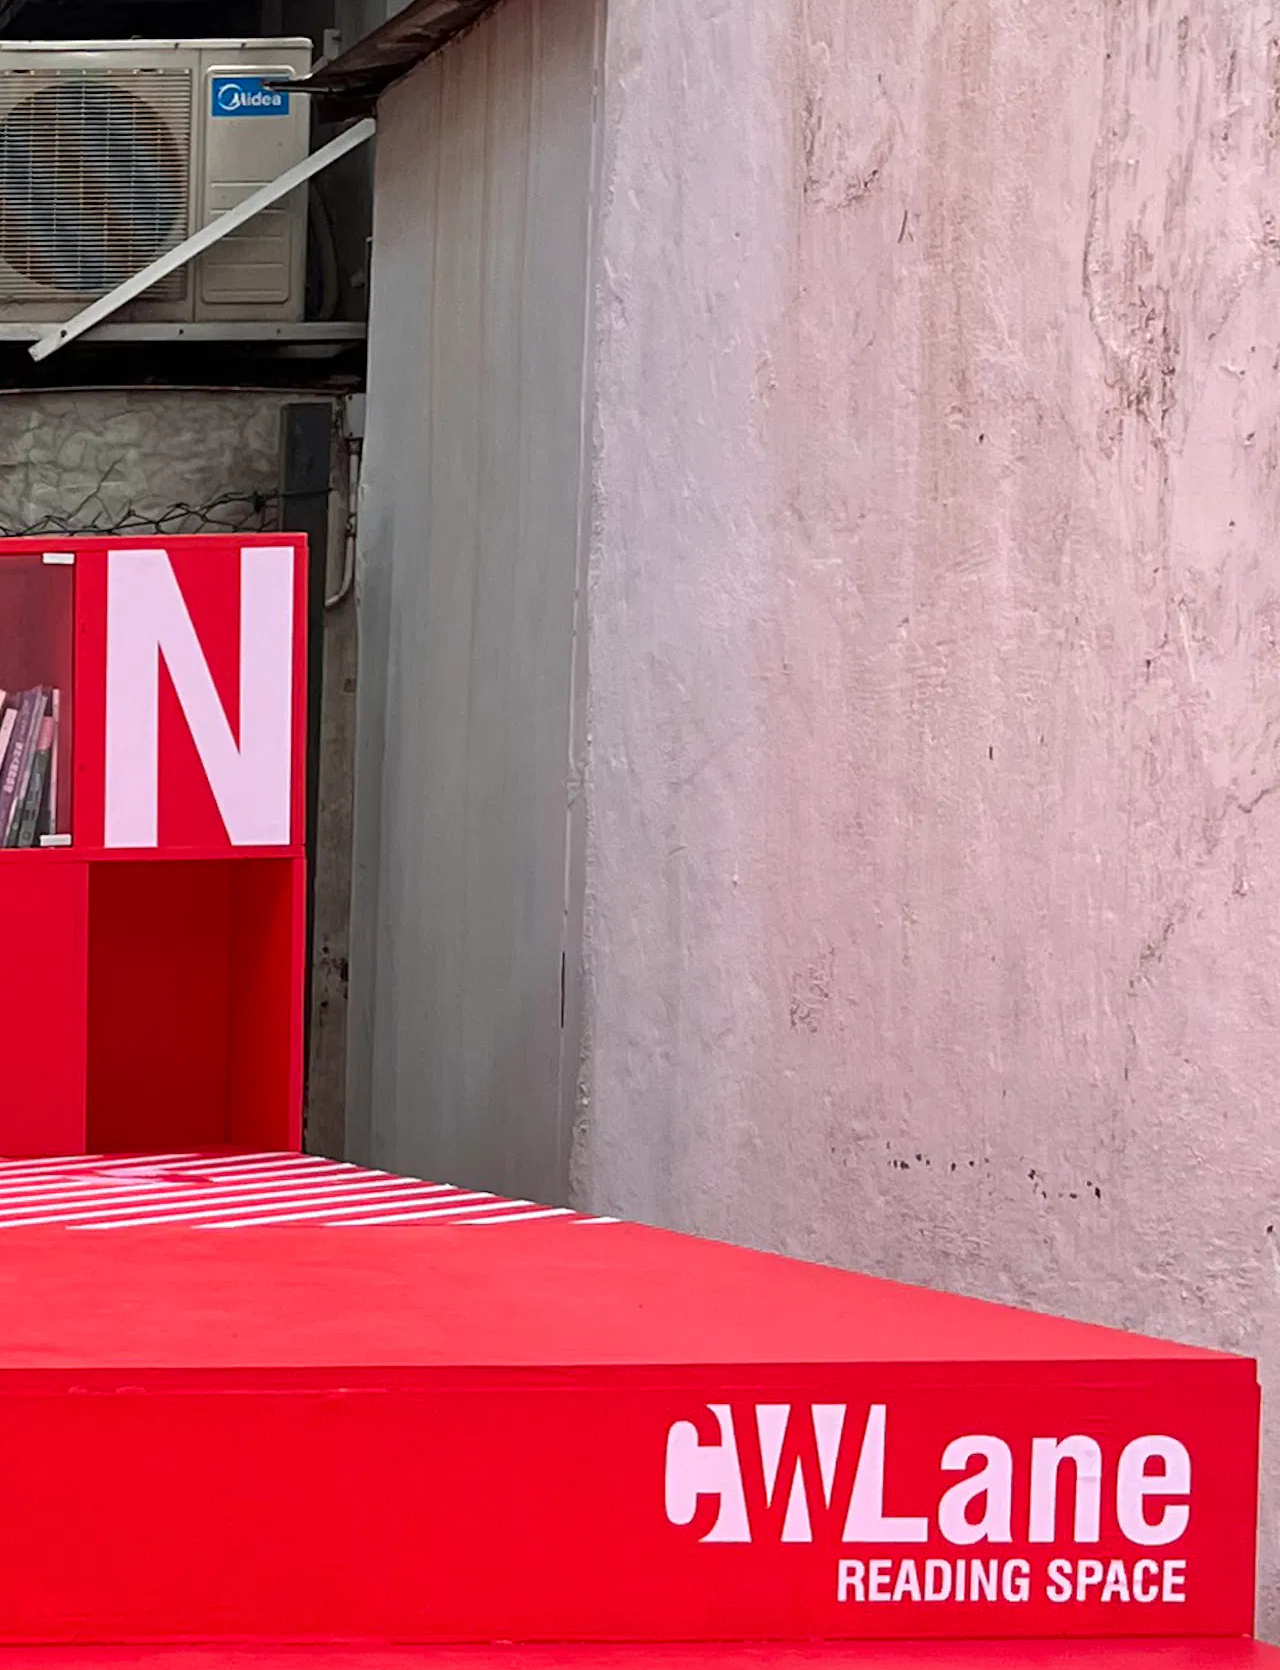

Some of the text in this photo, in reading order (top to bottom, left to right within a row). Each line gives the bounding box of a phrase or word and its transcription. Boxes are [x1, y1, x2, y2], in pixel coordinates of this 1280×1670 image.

[226, 88, 282, 108] Midea
[104, 546, 295, 848] N
[664, 1404, 1192, 1545] CWLane
[837, 1558, 1186, 1603] READING SPACE
